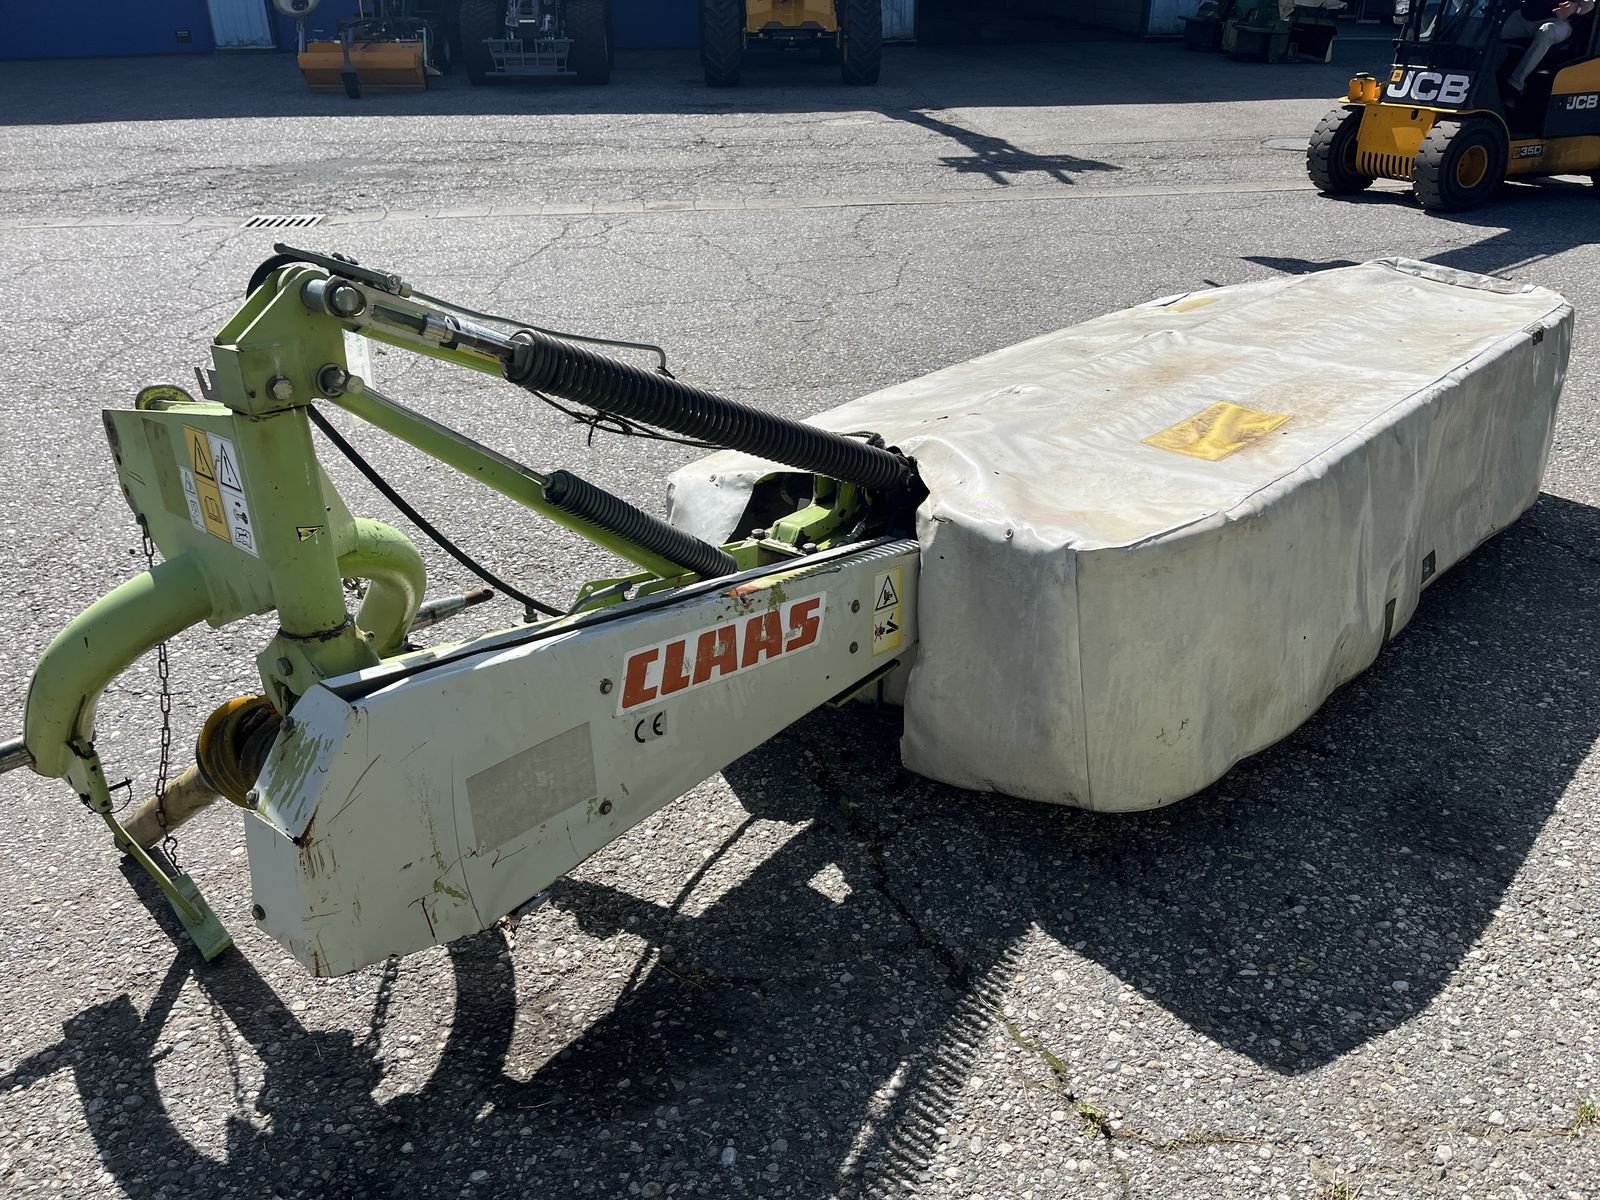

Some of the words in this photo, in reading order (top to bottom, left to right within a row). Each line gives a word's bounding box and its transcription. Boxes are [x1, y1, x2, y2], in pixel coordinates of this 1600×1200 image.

[1386, 71, 1470, 103] JCB
[1566, 95, 1598, 110] JCB
[622, 597, 820, 708] CLAAS
[634, 711, 664, 743] CE
